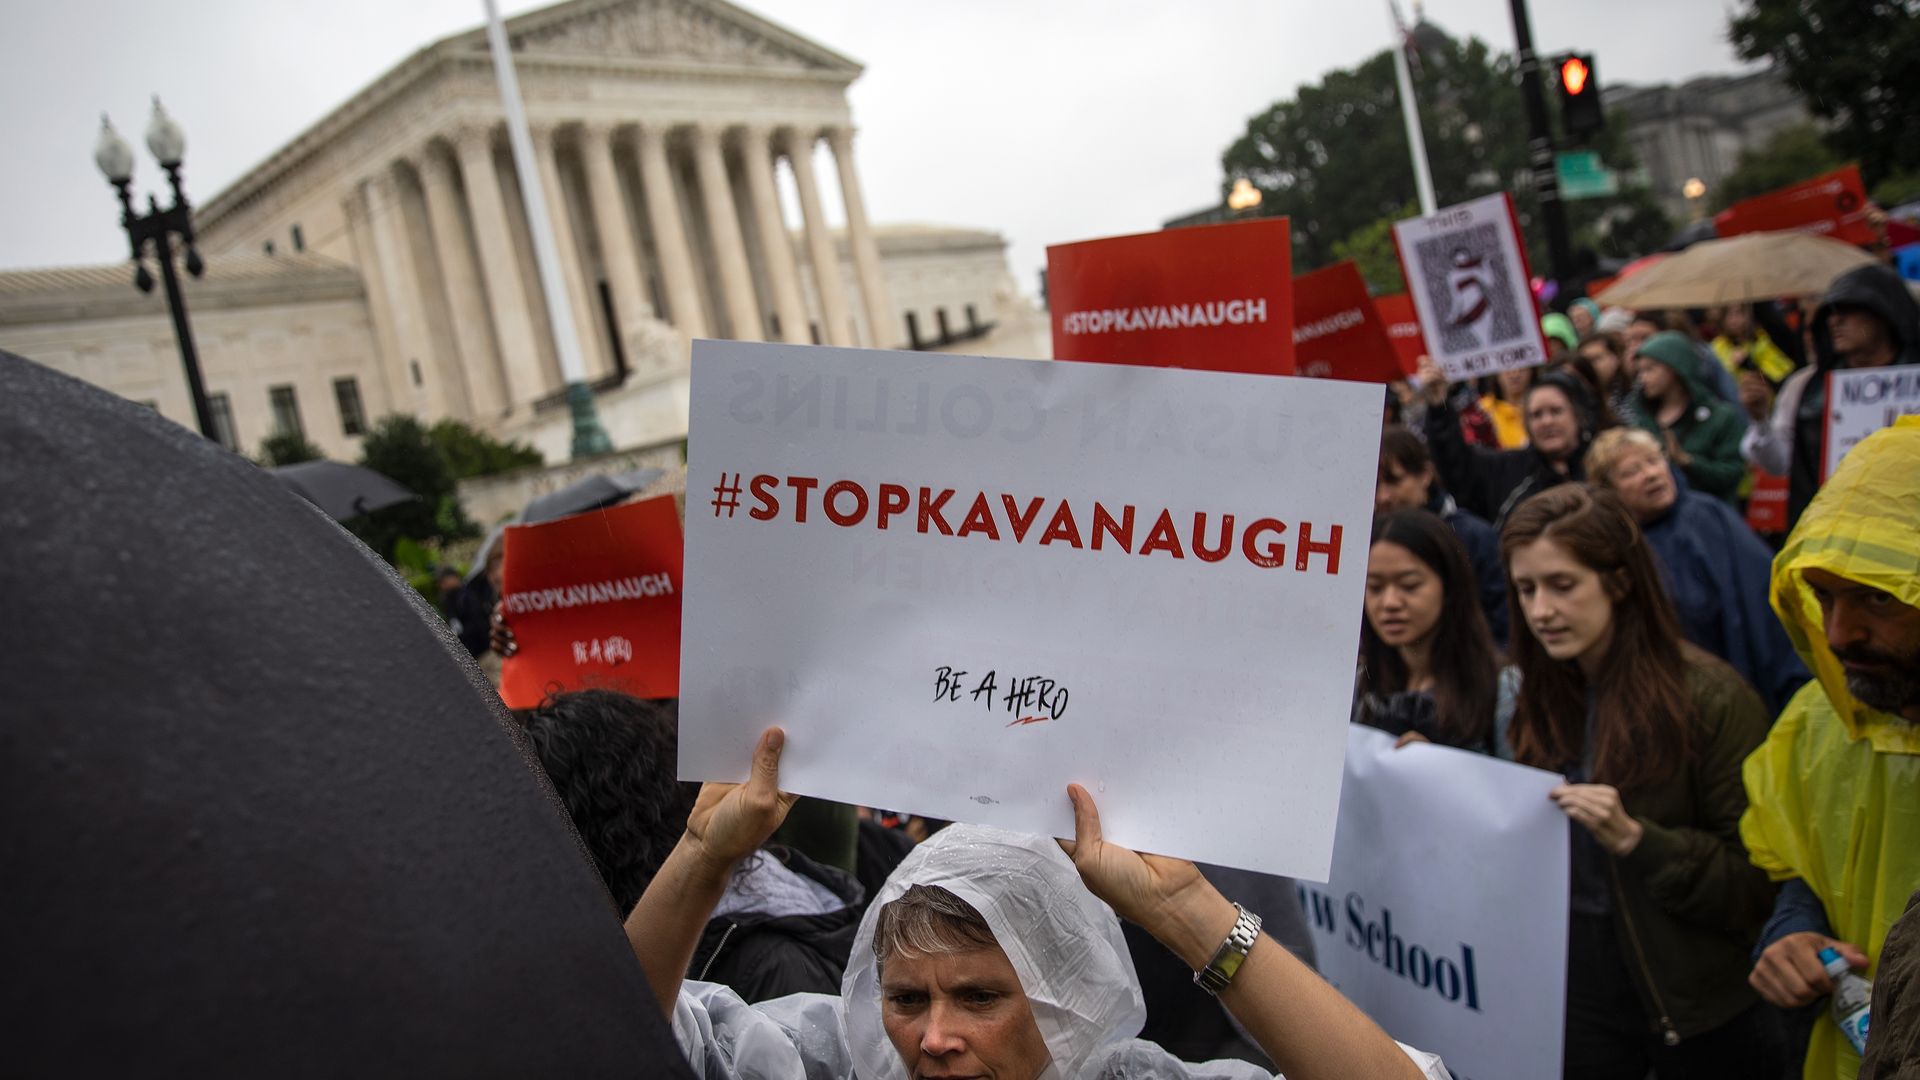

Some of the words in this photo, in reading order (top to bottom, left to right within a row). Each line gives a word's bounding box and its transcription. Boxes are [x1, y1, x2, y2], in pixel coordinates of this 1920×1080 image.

[1063, 297, 1267, 335] #STOPKAVANAUGH
[711, 472, 1343, 575] #STOPKAVANAUGH
[933, 666, 968, 703] BE
[970, 669, 997, 712] A
[1003, 676, 1068, 720] HERO
[1345, 891, 1484, 1013] School
